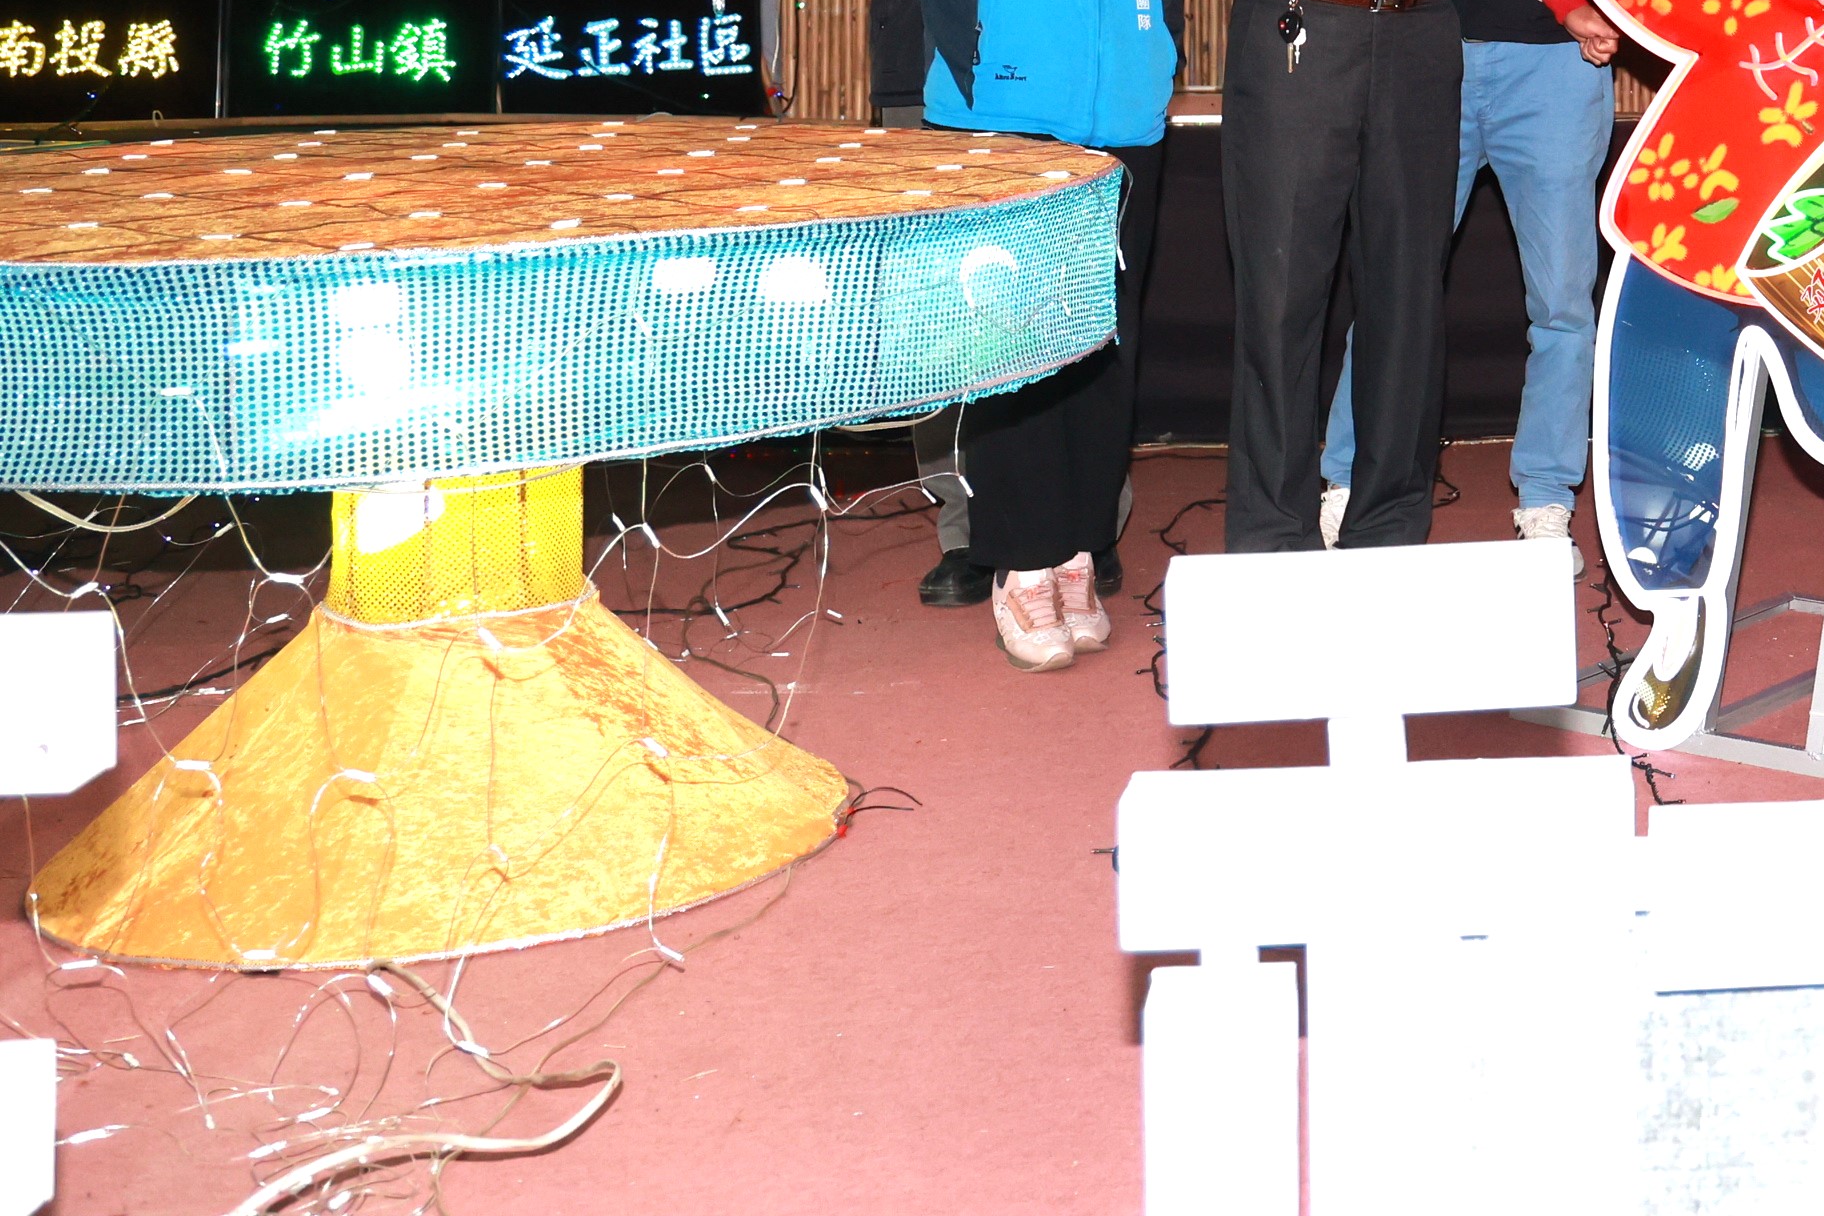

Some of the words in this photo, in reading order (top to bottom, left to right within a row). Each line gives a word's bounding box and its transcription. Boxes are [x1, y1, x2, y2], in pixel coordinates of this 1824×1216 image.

[0, 19, 180, 78] 南投縣
[264, 18, 457, 82] 竹山鎮
[504, 15, 752, 78] 延正社區
